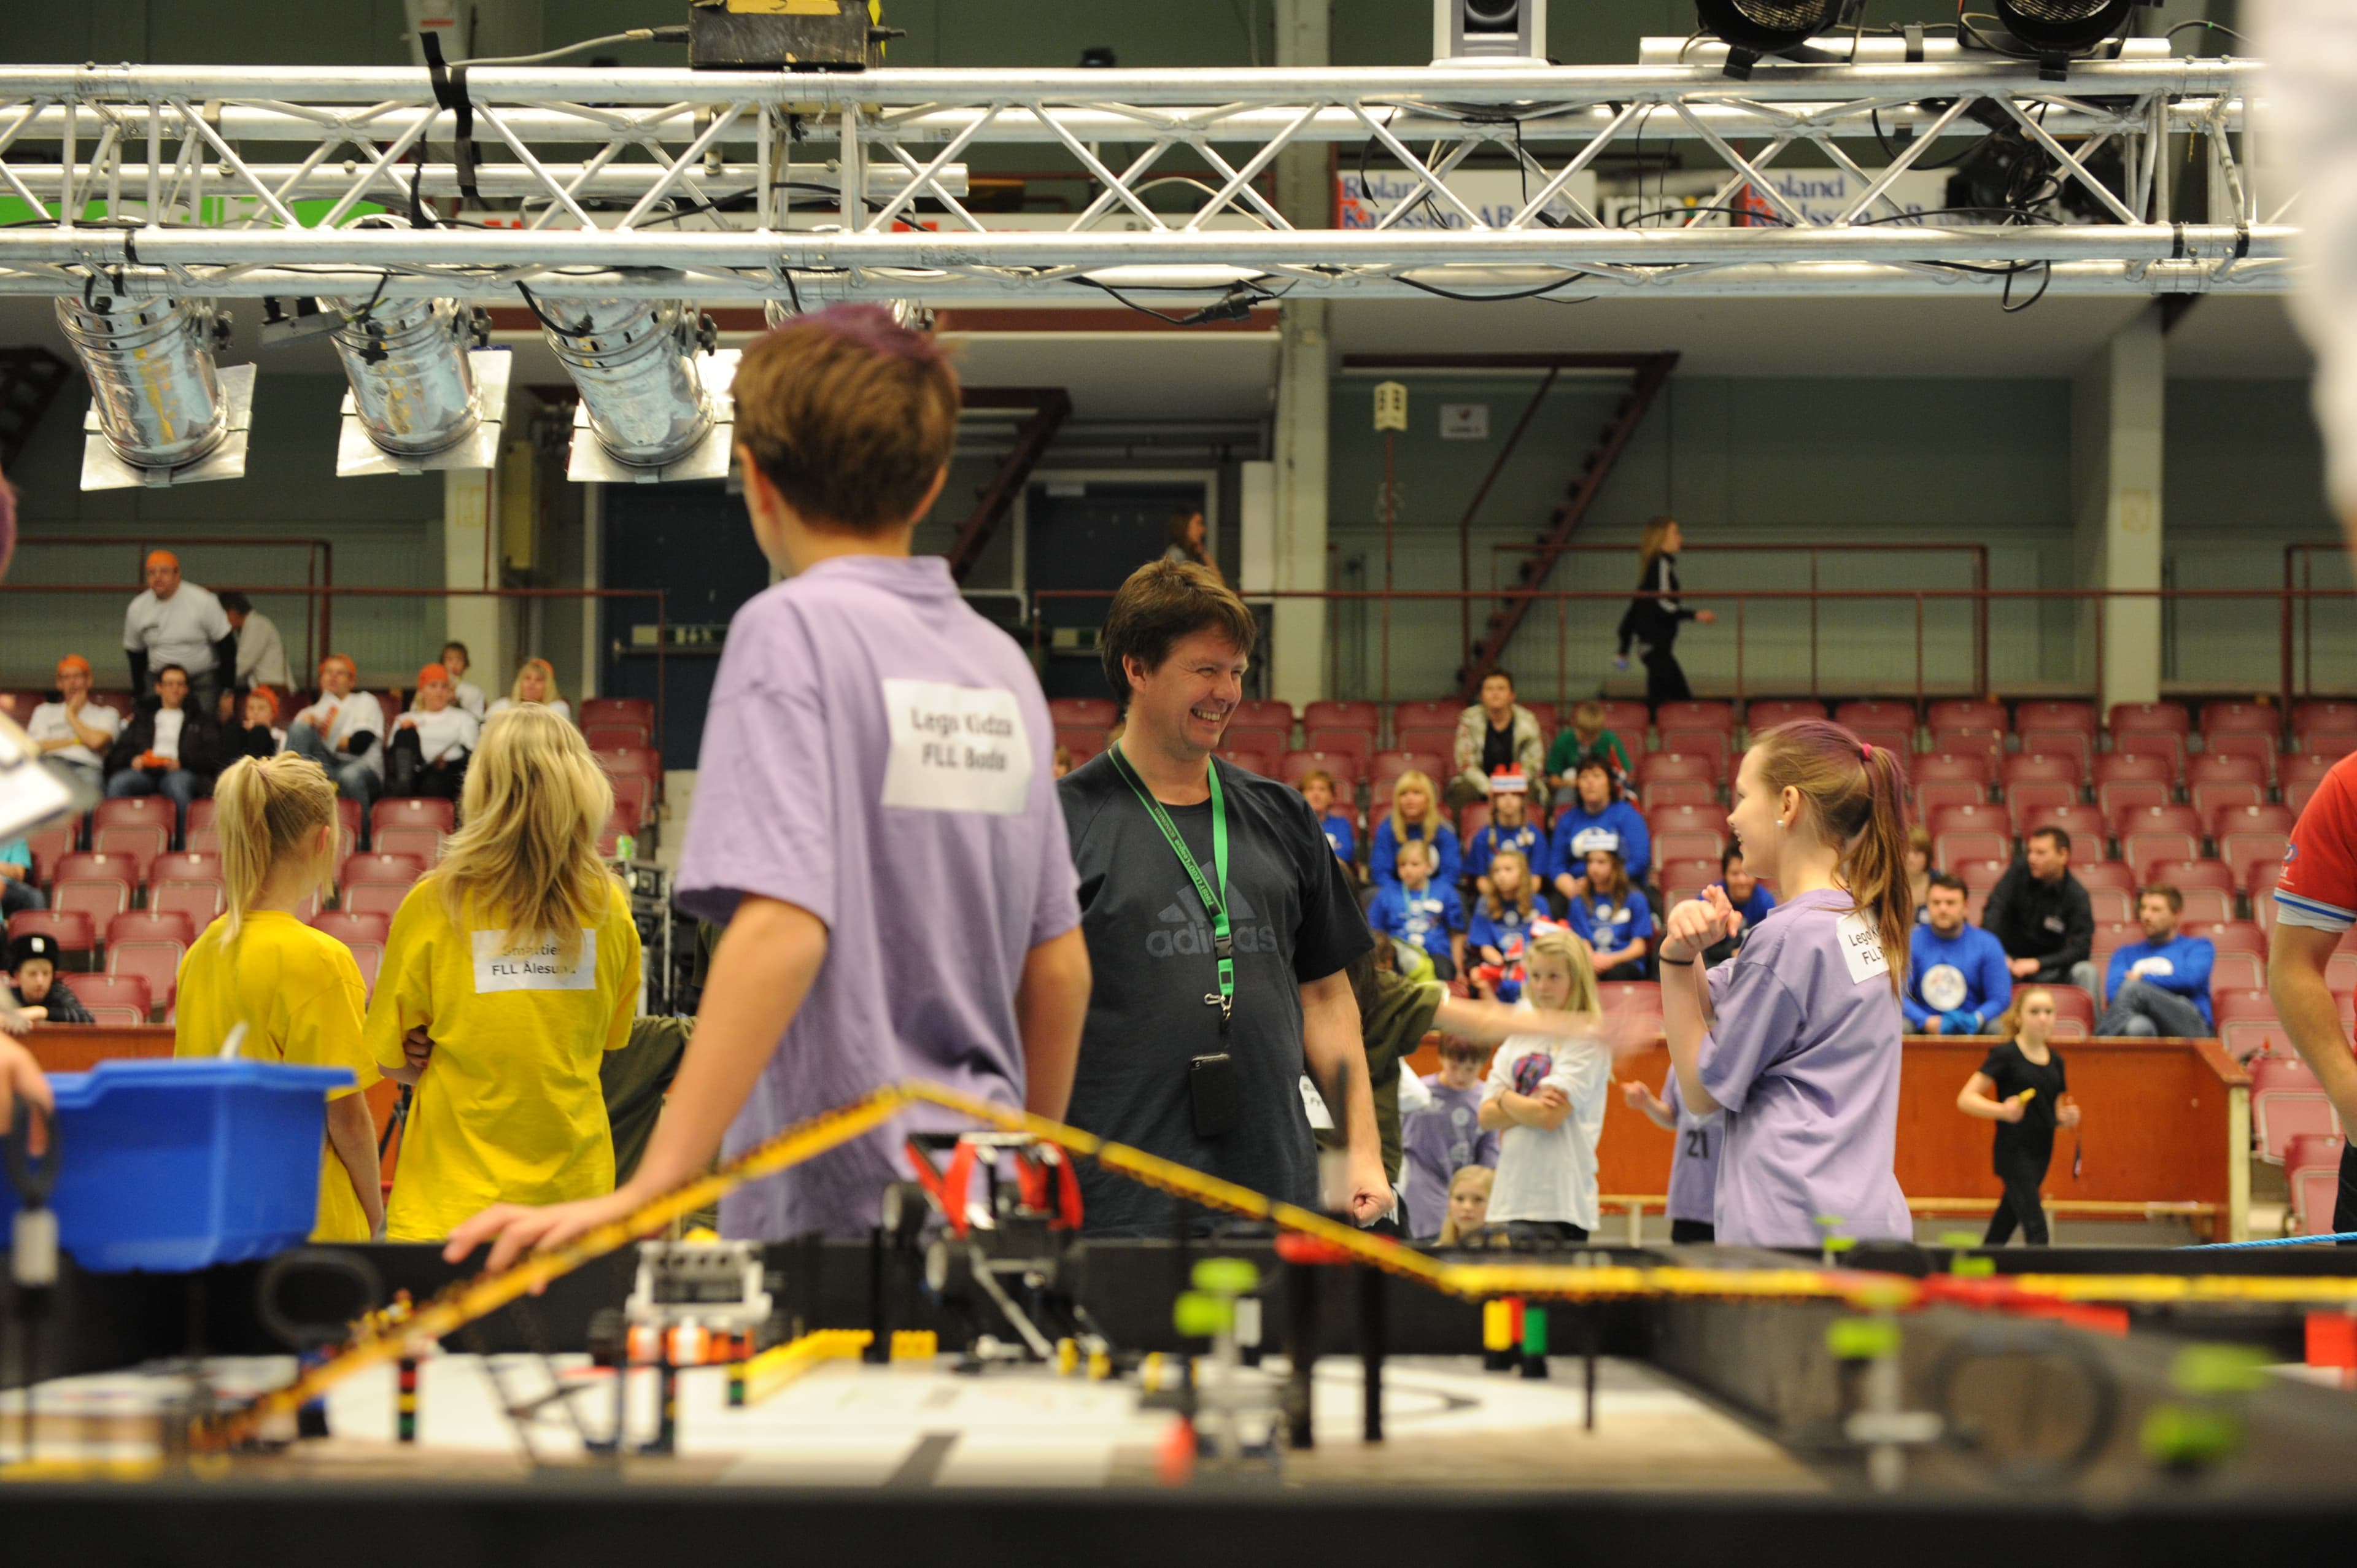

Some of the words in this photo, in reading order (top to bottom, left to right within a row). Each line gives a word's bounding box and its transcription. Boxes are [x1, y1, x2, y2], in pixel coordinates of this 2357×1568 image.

[921, 743, 958, 769] FLL
[1145, 922, 1277, 957] adias
[1848, 930, 1871, 946] Lego
[1862, 949, 1881, 965] FLL
[492, 964, 518, 975] FLL
[1686, 1130, 1709, 1159] 21
